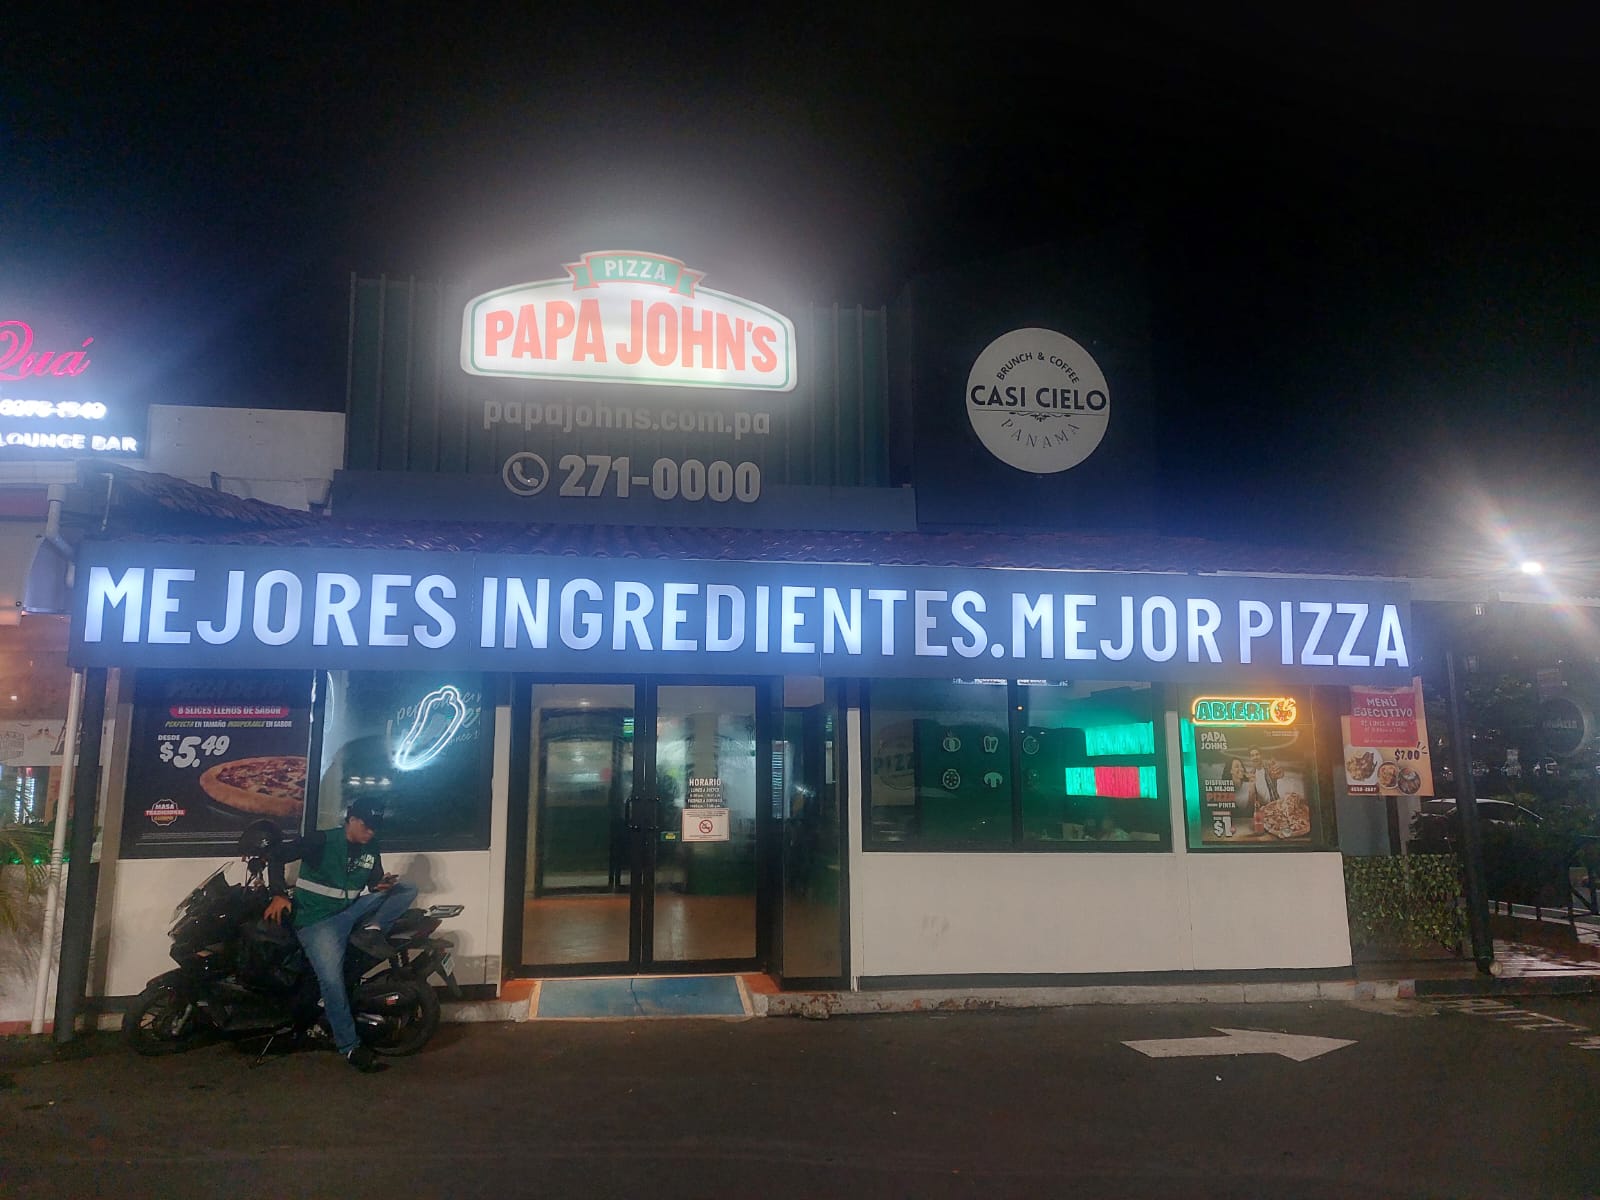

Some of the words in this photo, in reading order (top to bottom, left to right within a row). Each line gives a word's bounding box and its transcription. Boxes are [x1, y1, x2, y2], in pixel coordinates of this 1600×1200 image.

[603, 259, 666, 281] PIZZA
[484, 298, 608, 363] PAPA
[615, 299, 778, 373] JOHN'S
[996, 352, 1033, 381] BRUNCH
[1037, 351, 1045, 361] &
[1049, 355, 1080, 384] COFFEE
[970, 385, 1026, 407] CASI
[1035, 387, 1107, 411] CIELO
[483, 399, 771, 440] papajohns.com.pa
[91, 435, 137, 451] BAR
[558, 454, 761, 503] 271-0000
[84, 566, 457, 649] MEJORES
[480, 577, 1005, 659] INGREDIENTES.
[1012, 593, 1223, 663] MEJOR
[1238, 600, 1410, 668] PIZZA
[1366, 695, 1398, 707] MENÚ
[243, 706, 254, 715] DE
[1353, 707, 1413, 718] EJECUTIVO
[1201, 731, 1226, 742] PAPA
[1201, 742, 1228, 750] JOHNS
[1394, 749, 1420, 760] $7.00
[689, 778, 721, 786] HORARIO
[1206, 793, 1236, 802] PIZZA
